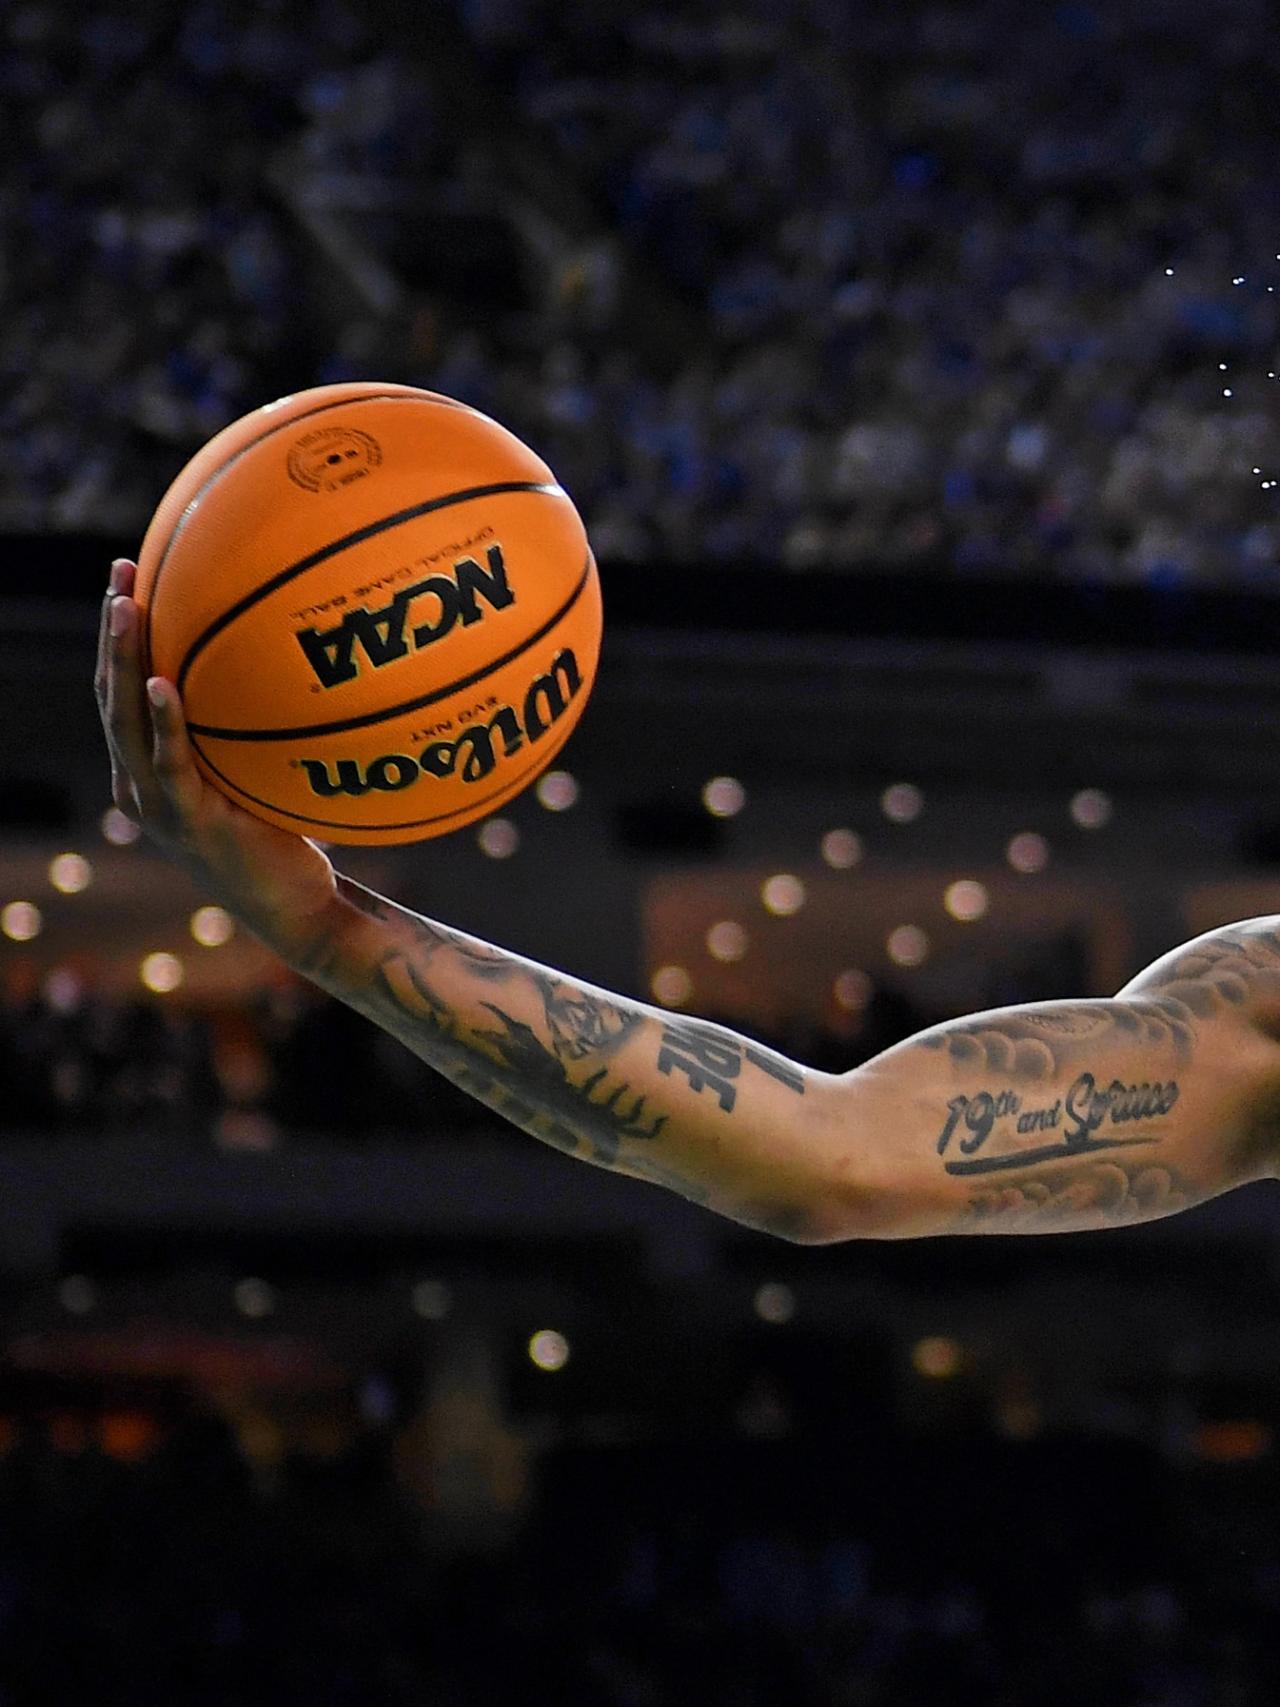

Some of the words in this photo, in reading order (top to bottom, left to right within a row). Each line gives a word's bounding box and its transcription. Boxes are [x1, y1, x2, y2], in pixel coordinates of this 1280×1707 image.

[354, 567, 412, 597] GAME
[291, 594, 348, 619] BALL
[296, 544, 515, 689] NCAA
[301, 647, 582, 796] Wilson
[458, 696, 498, 724] EVO
[410, 718, 453, 742] NXT
[1016, 1099, 1062, 1135] and
